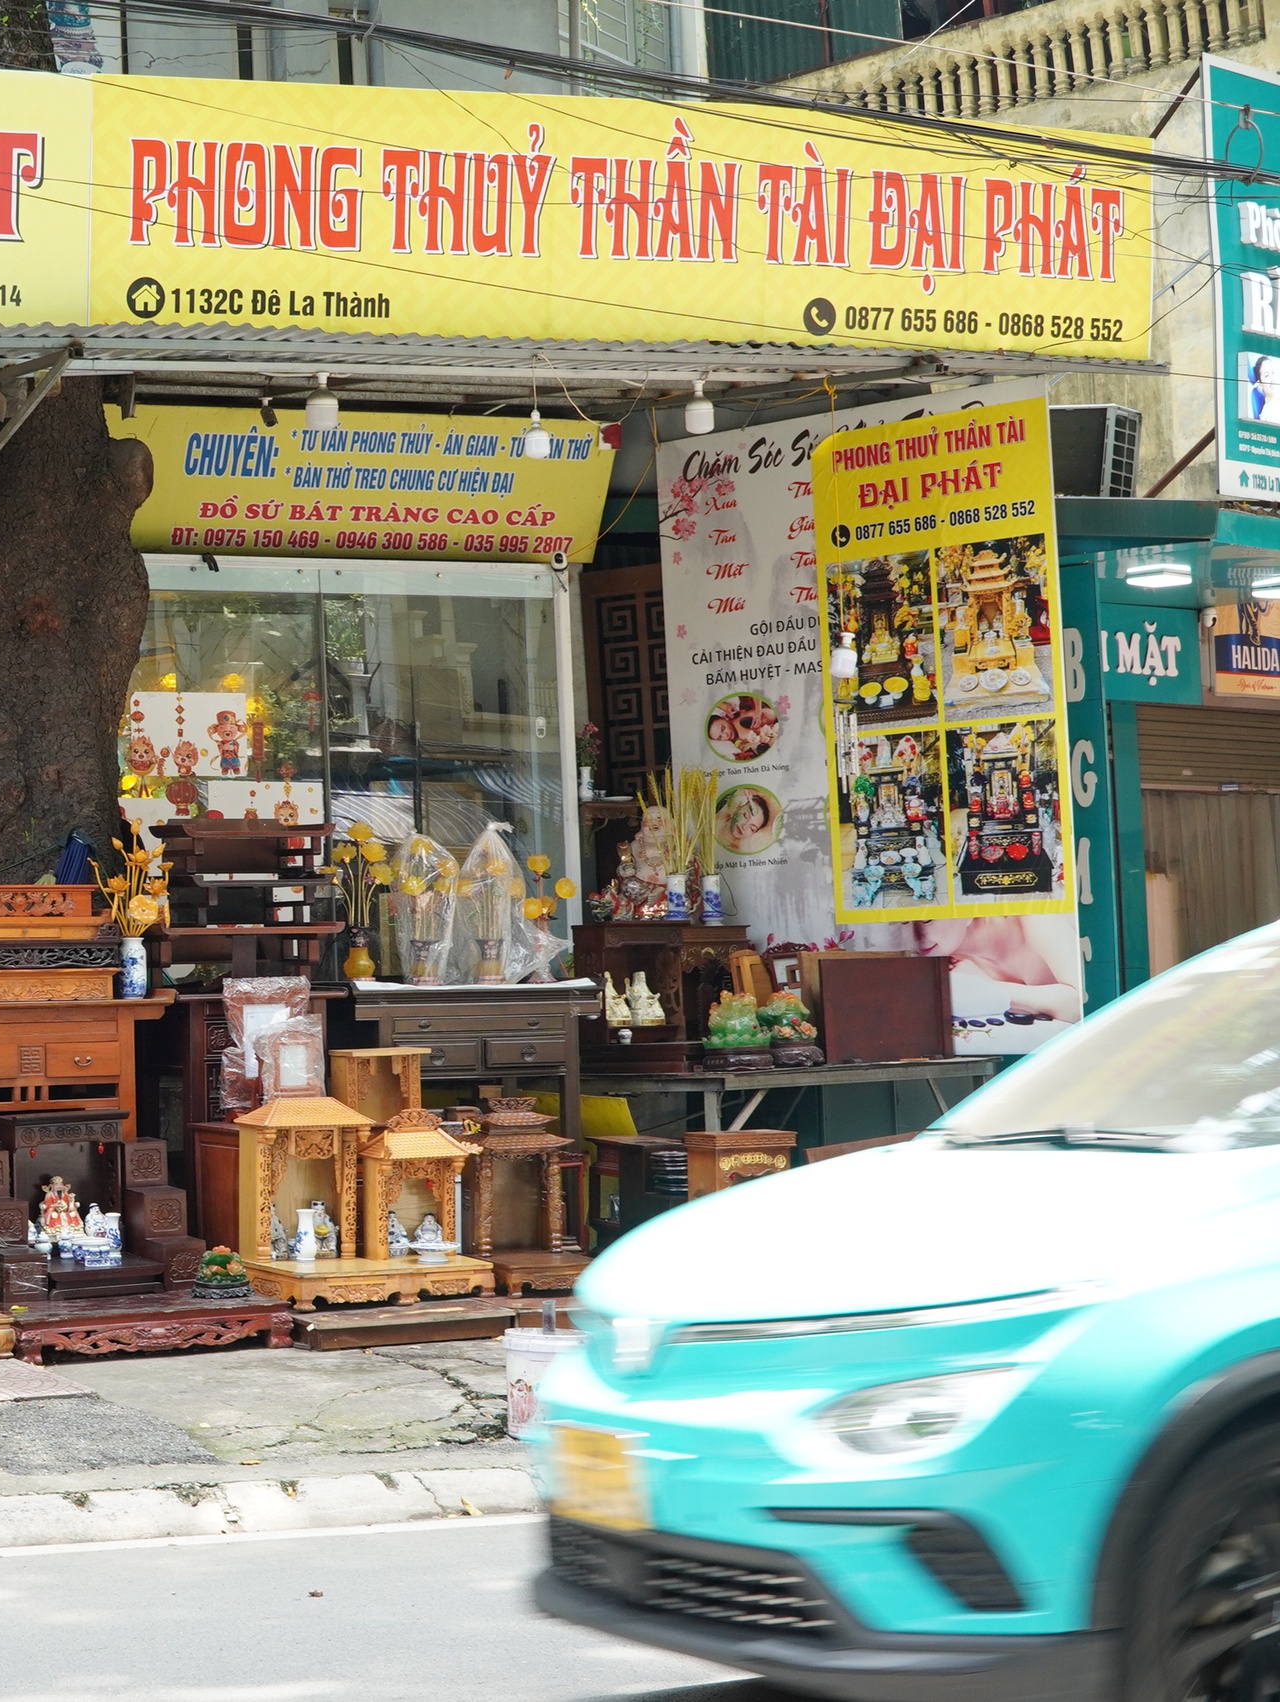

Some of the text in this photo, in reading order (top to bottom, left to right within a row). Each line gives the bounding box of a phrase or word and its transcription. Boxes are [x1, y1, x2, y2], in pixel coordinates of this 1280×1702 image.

[129, 116, 1125, 295] PHONG THUỶ THẦN TÀI ĐẠI PHÁT
[171, 287, 390, 318] 1132C Đê La Thành
[845, 306, 894, 331] 0877
[901, 309, 937, 333] 655
[943, 310, 978, 335] 686
[999, 312, 1048, 338] 0868
[1051, 316, 1085, 340] 528
[1090, 318, 1123, 342] 552
[184, 426, 279, 477] CHUYÊN:
[350, 430, 397, 453] PHONG
[443, 429, 465, 455] ÁN
[466, 434, 499, 457] GIAN
[567, 434, 594, 460] THỜ
[683, 445, 741, 483] Chăm
[747, 437, 784, 475] Sóc
[832, 441, 891, 473] PHONG
[896, 426, 940, 462] THUỶ
[944, 419, 992, 453] THẦN
[996, 416, 1026, 445] TÀI
[293, 462, 515, 498] BÀN THỜ TREO CHUNG CƯ HIỆN ĐẠI
[858, 460, 1003, 510] ĐẠI PHÁT
[199, 495, 556, 526] ĐỒ SỨ BÁT TRÀNG CAO CẤP
[855, 523, 885, 541] 0877
[888, 518, 910, 536] 655
[914, 515, 936, 532] 686
[949, 508, 980, 527] 0868
[984, 504, 1008, 521] 528
[1011, 500, 1035, 517] 552
[171, 527, 198, 546] ĐT:
[203, 528, 246, 547] 0975
[253, 529, 283, 548] 150
[287, 530, 319, 549] 469
[336, 531, 377, 549] 0946
[381, 531, 413, 551] 300
[417, 533, 448, 551] 586
[464, 534, 494, 552] 035
[499, 534, 529, 553] 995
[533, 536, 574, 554] 2807
[750, 620, 773, 636] GỘI
[692, 649, 712, 665] CẢI
[715, 645, 753, 662] THIỆN
[756, 642, 785, 657] ĐAU
[1116, 621, 1181, 686] MẶT
[1231, 645, 1280, 672] HALIDA
[706, 668, 737, 685] BẤM
[740, 664, 782, 681] HUYỆT
